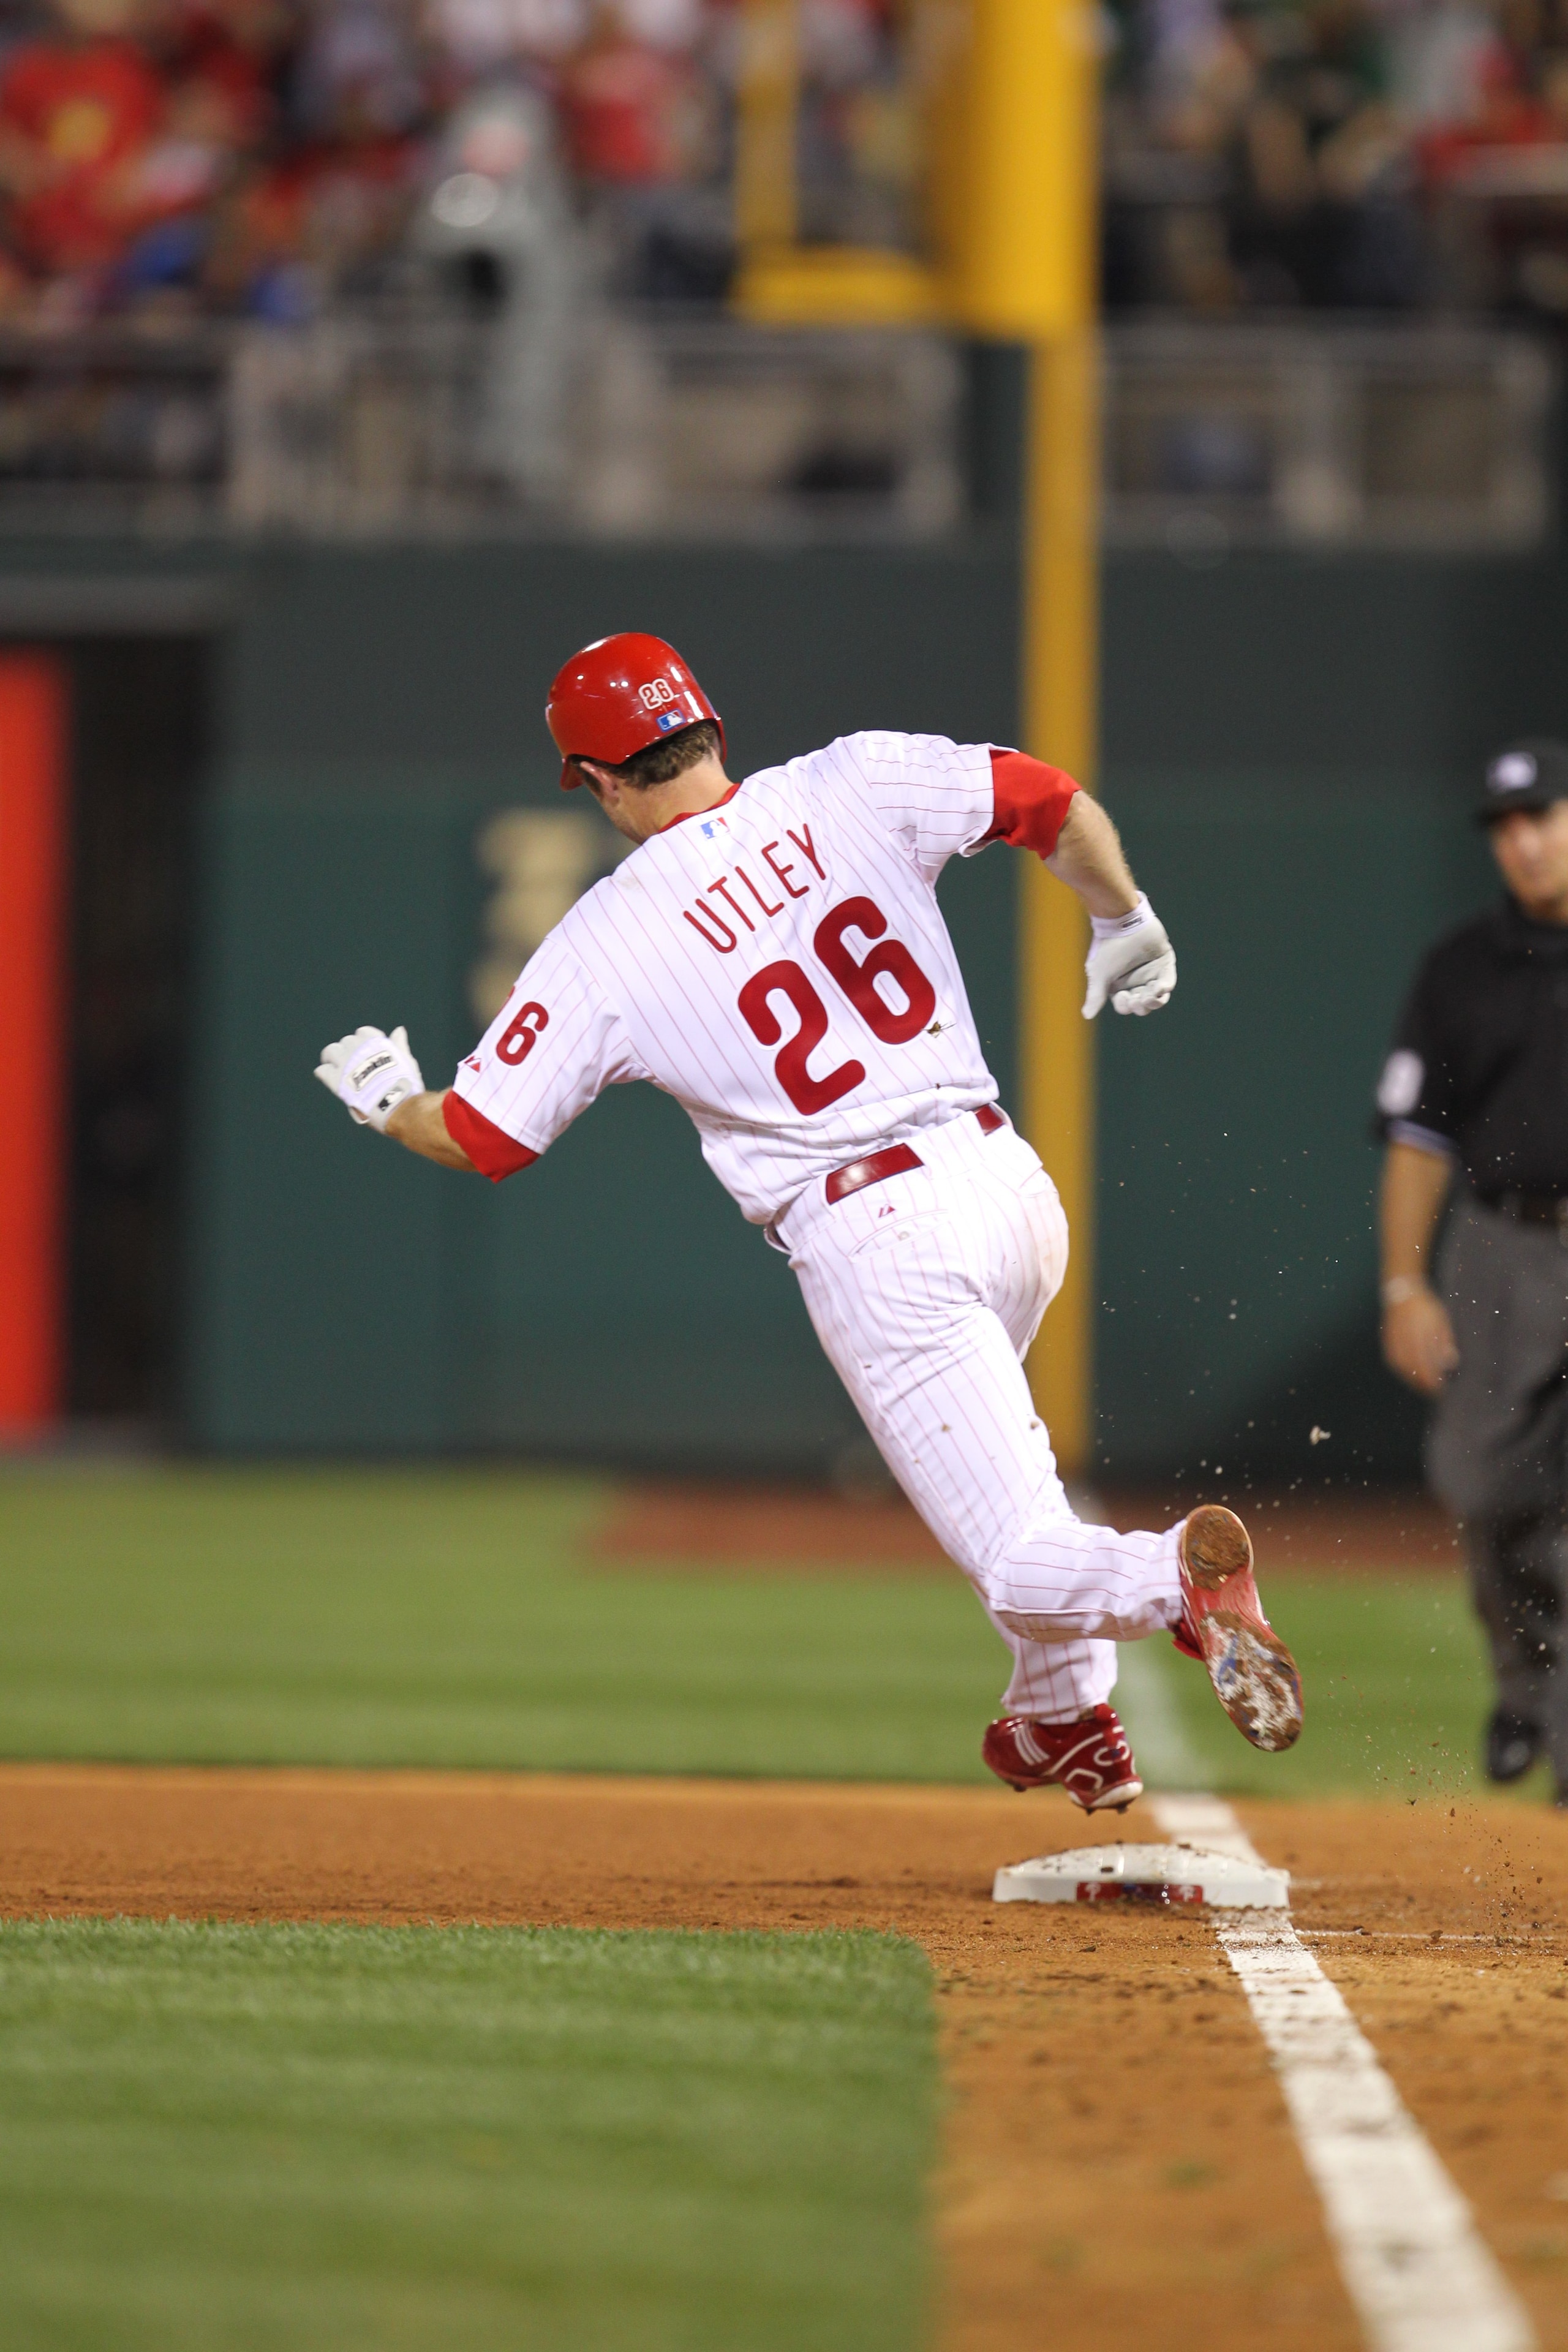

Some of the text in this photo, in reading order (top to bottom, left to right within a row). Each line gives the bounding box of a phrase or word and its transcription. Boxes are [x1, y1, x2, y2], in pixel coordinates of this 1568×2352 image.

[638, 678, 674, 709] 26
[684, 823, 826, 953] UTLEY
[494, 986, 549, 1065] 6
[738, 895, 936, 1115] 26
